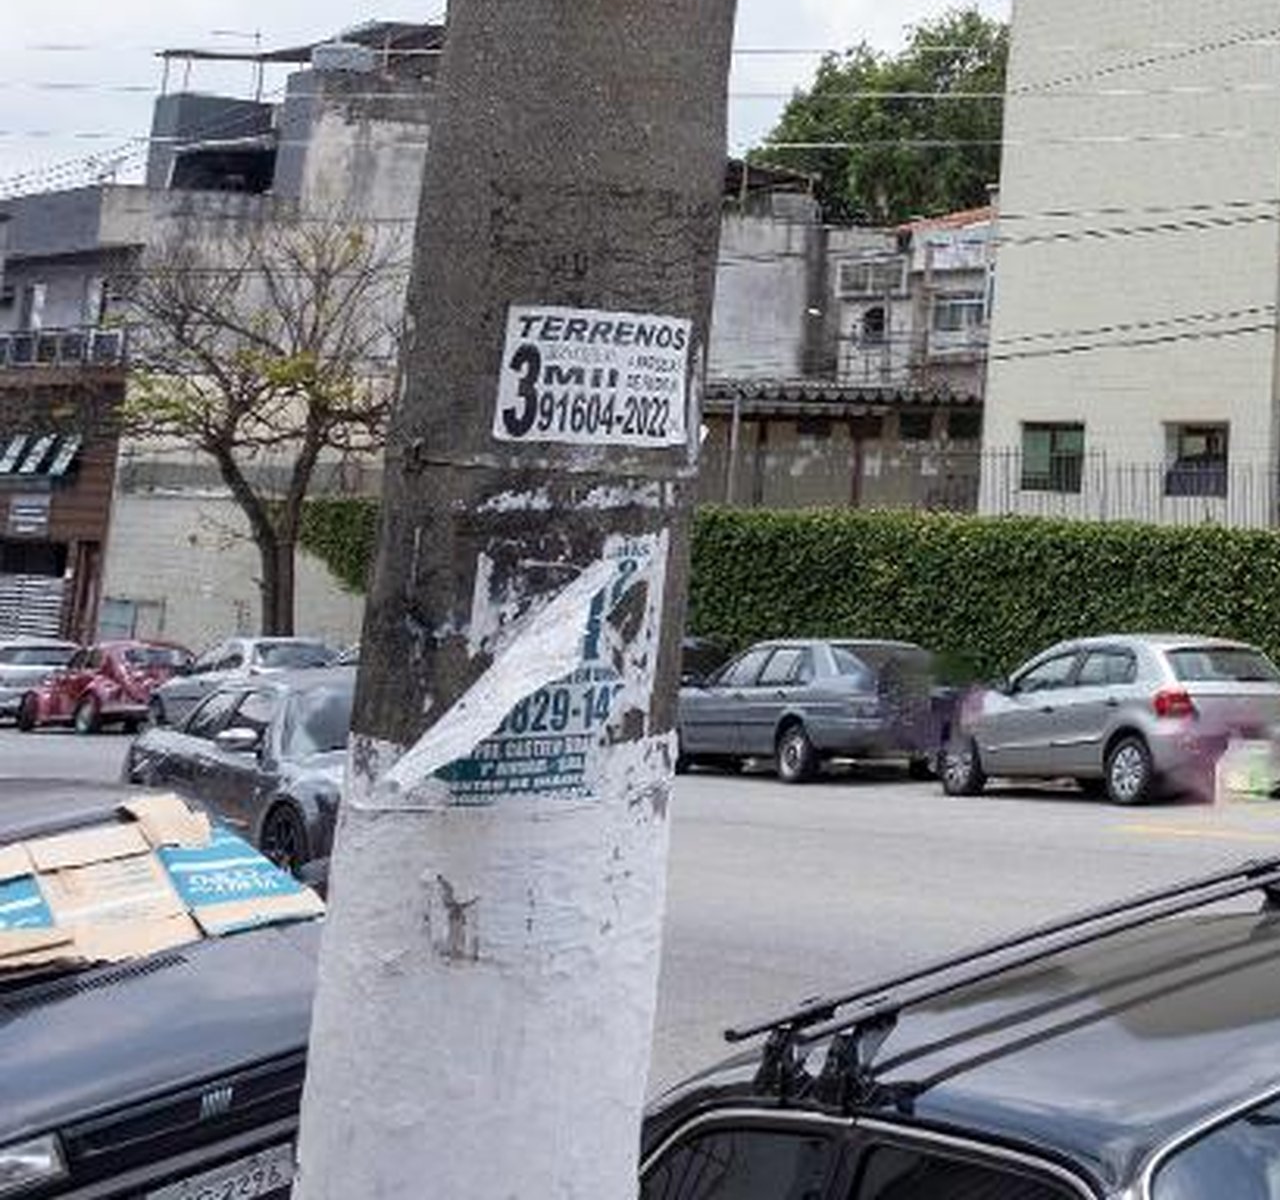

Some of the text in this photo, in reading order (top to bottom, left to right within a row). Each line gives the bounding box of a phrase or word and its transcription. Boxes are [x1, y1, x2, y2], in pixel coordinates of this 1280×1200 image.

[519, 315, 686, 350] TERRENOS
[503, 343, 541, 437] 3
[537, 391, 669, 437] 91604-2022
